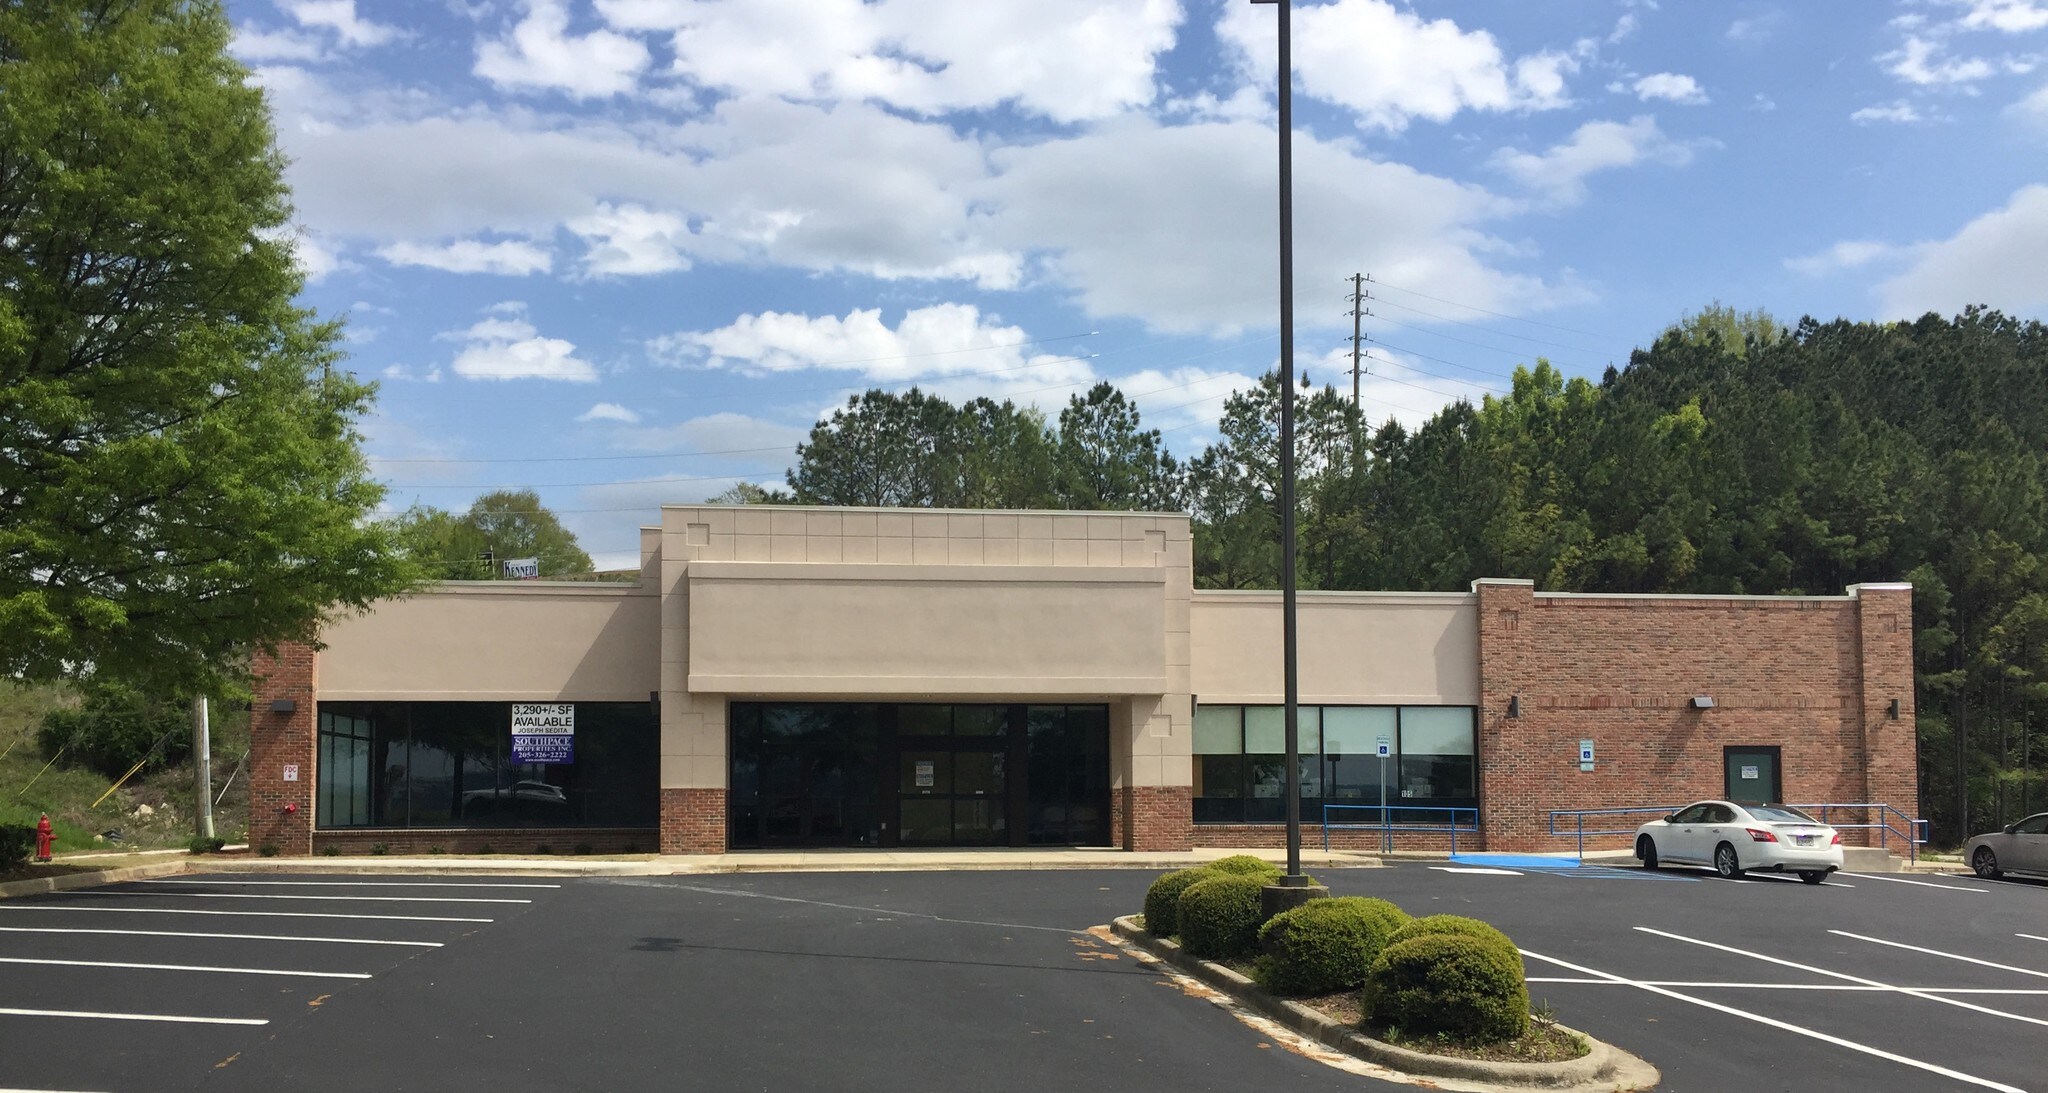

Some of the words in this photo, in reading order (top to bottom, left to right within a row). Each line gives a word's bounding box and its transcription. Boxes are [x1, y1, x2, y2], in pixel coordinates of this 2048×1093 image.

[514, 705, 556, 716] 3,290+/-
[558, 705, 572, 714] SF
[514, 717, 572, 726] AVAILABLE
[515, 736, 570, 746] SOUTHPACE
